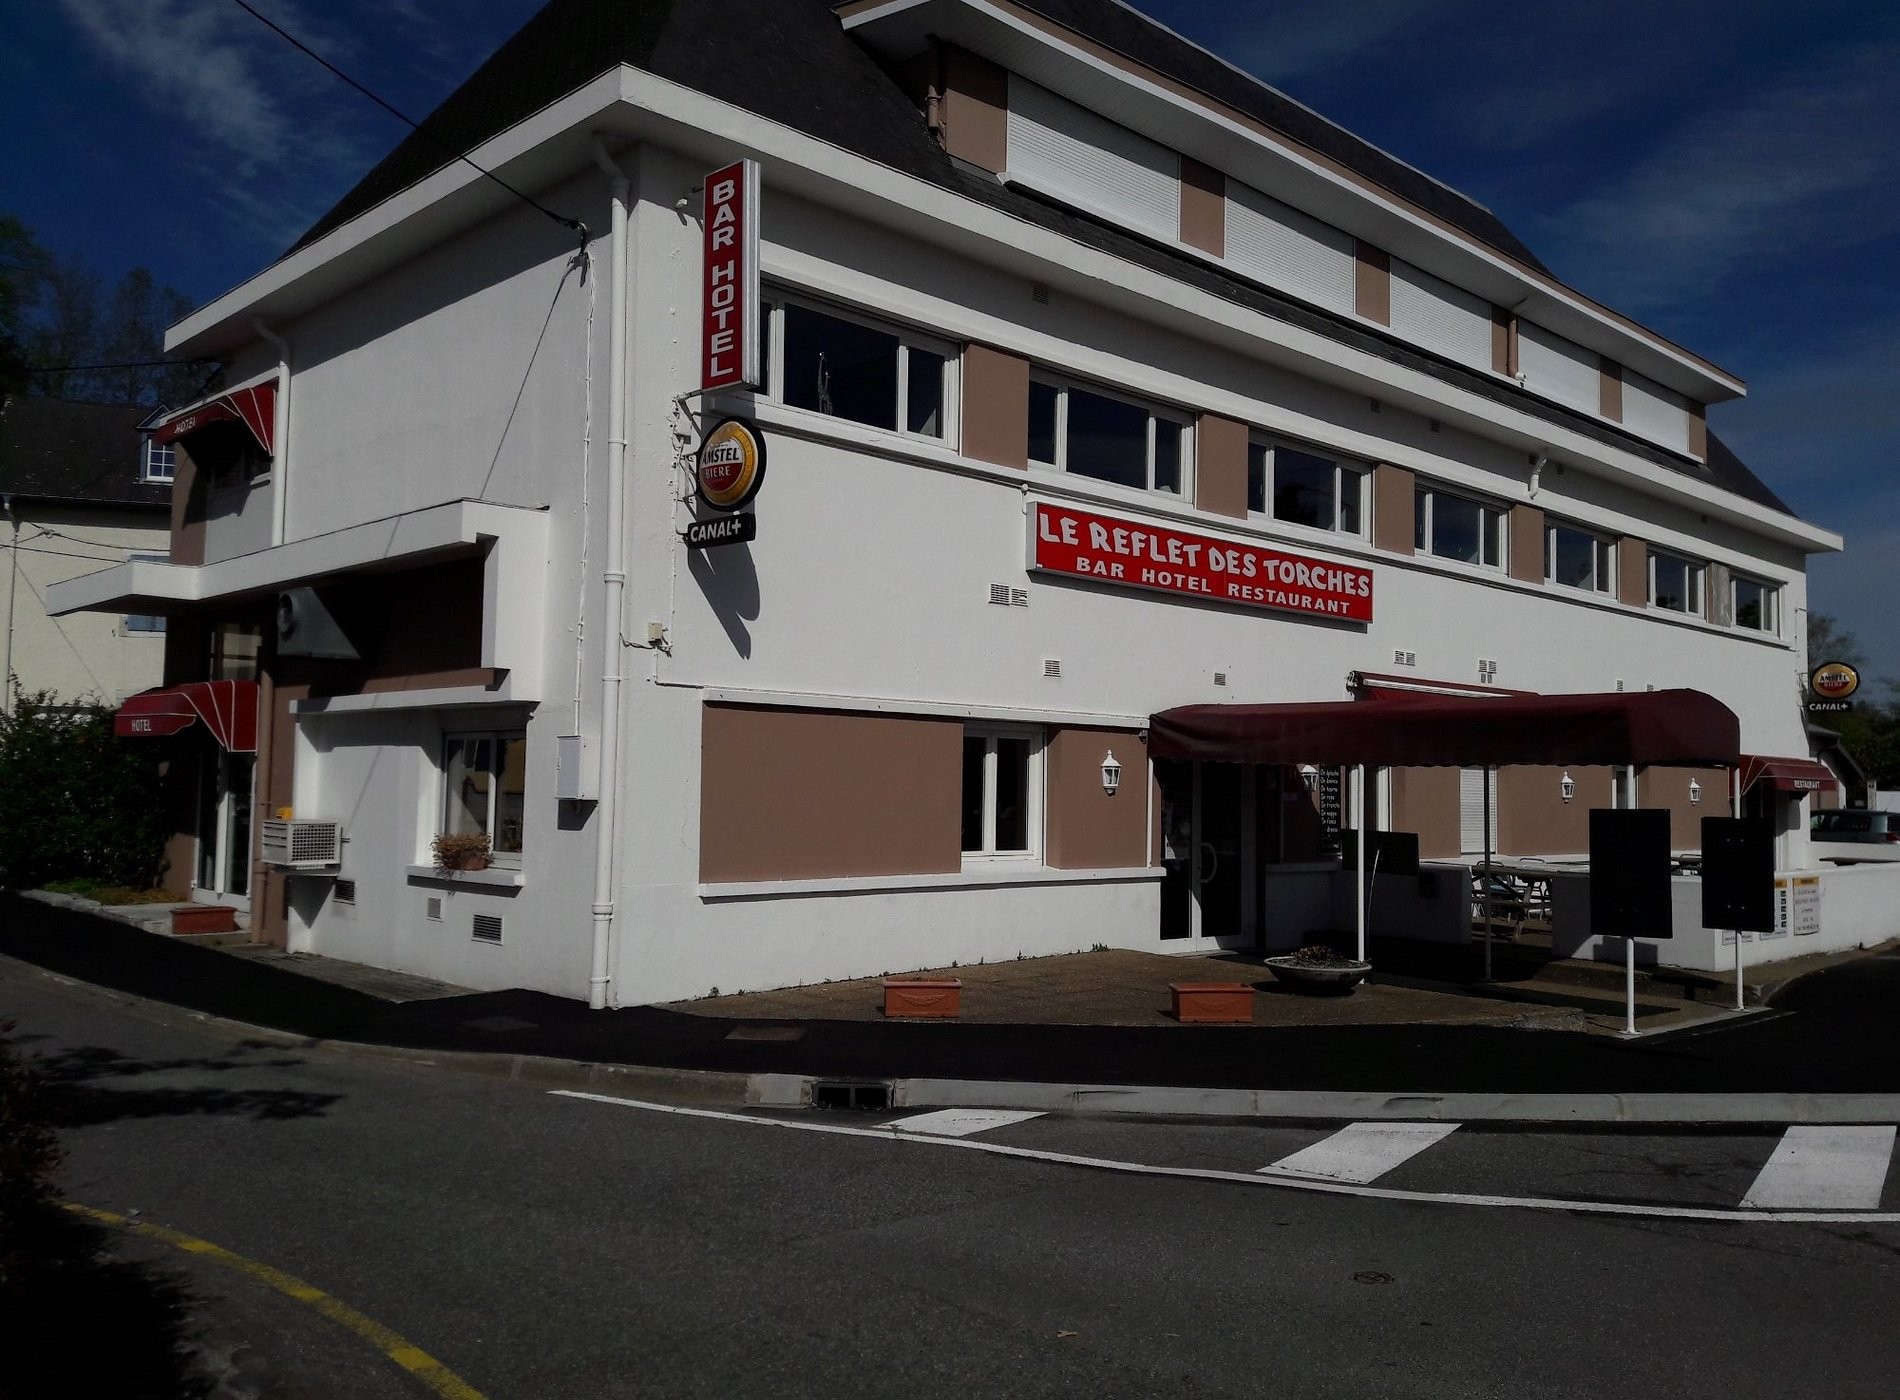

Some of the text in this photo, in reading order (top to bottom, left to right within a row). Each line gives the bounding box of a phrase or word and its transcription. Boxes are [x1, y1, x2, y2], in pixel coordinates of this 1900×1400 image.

[710, 179, 735, 378] BAR HOTEL
[702, 447, 740, 465] AMSTEL
[705, 466, 731, 479] BIERE
[690, 518, 741, 543] CANAL+
[1039, 512, 1370, 598] LE REFLET DES TORCHES
[1076, 556, 1350, 614] BAR HOTEL RESTAURANT
[1809, 702, 1848, 711] CANAL+
[131, 719, 152, 732] HOTEL
